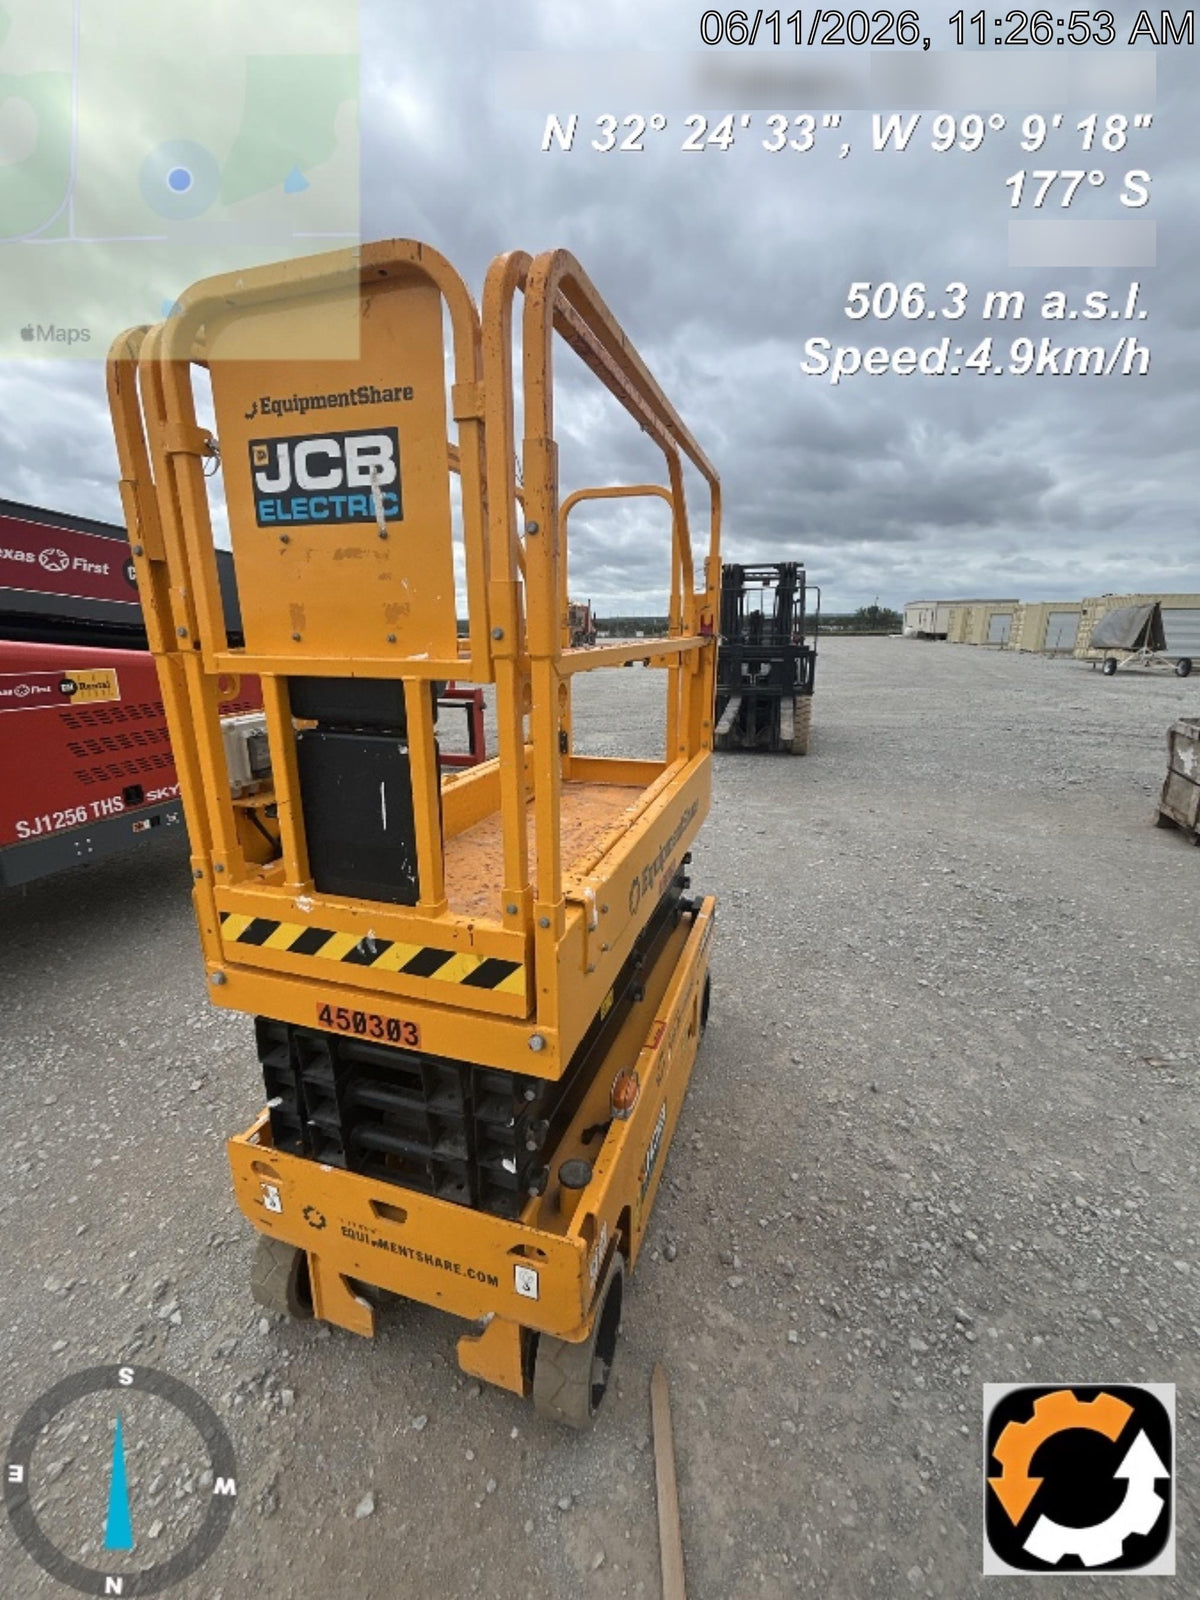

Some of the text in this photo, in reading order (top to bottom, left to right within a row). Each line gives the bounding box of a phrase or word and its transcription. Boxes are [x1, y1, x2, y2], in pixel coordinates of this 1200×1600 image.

[259, 385, 414, 418] EquipmentShare
[255, 434, 397, 493] JCB
[258, 492, 399, 522] ELECTRIC
[0, 548, 35, 563] xas
[72, 557, 110, 575] First
[145, 783, 182, 801] SKY
[15, 795, 125, 838] SJ1256 THS
[318, 1004, 419, 1046] 450303
[341, 1225, 499, 1287] EQUIMENTSHARE.COM
